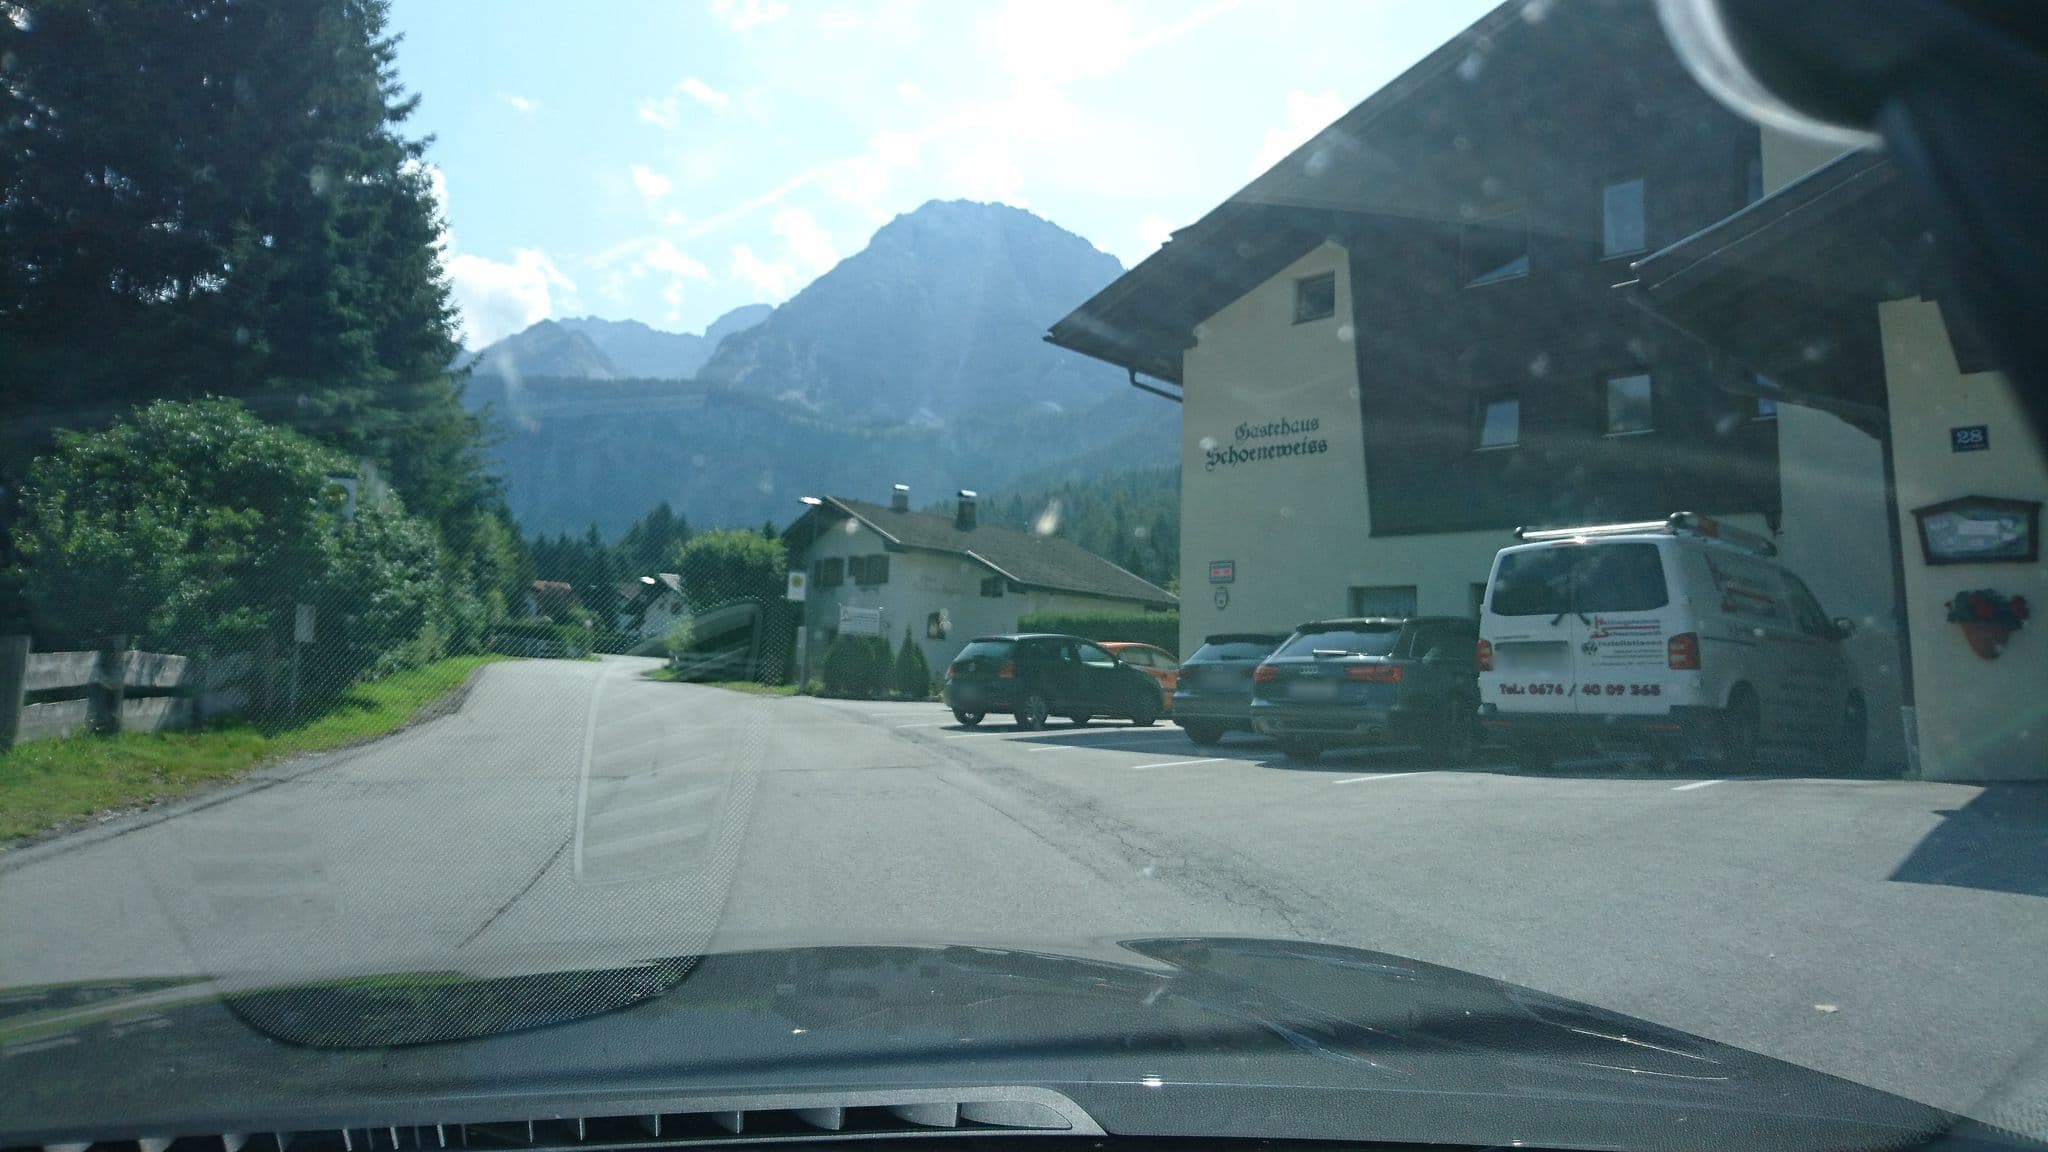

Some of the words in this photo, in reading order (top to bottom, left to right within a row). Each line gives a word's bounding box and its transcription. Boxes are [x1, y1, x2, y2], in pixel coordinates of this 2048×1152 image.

[1957, 429, 1983, 444] 28
[1205, 436, 1328, 472] Schoeneweiss
[1528, 683, 1564, 695] 0676
[1582, 683, 1601, 695] 40
[1606, 683, 1625, 695] 09
